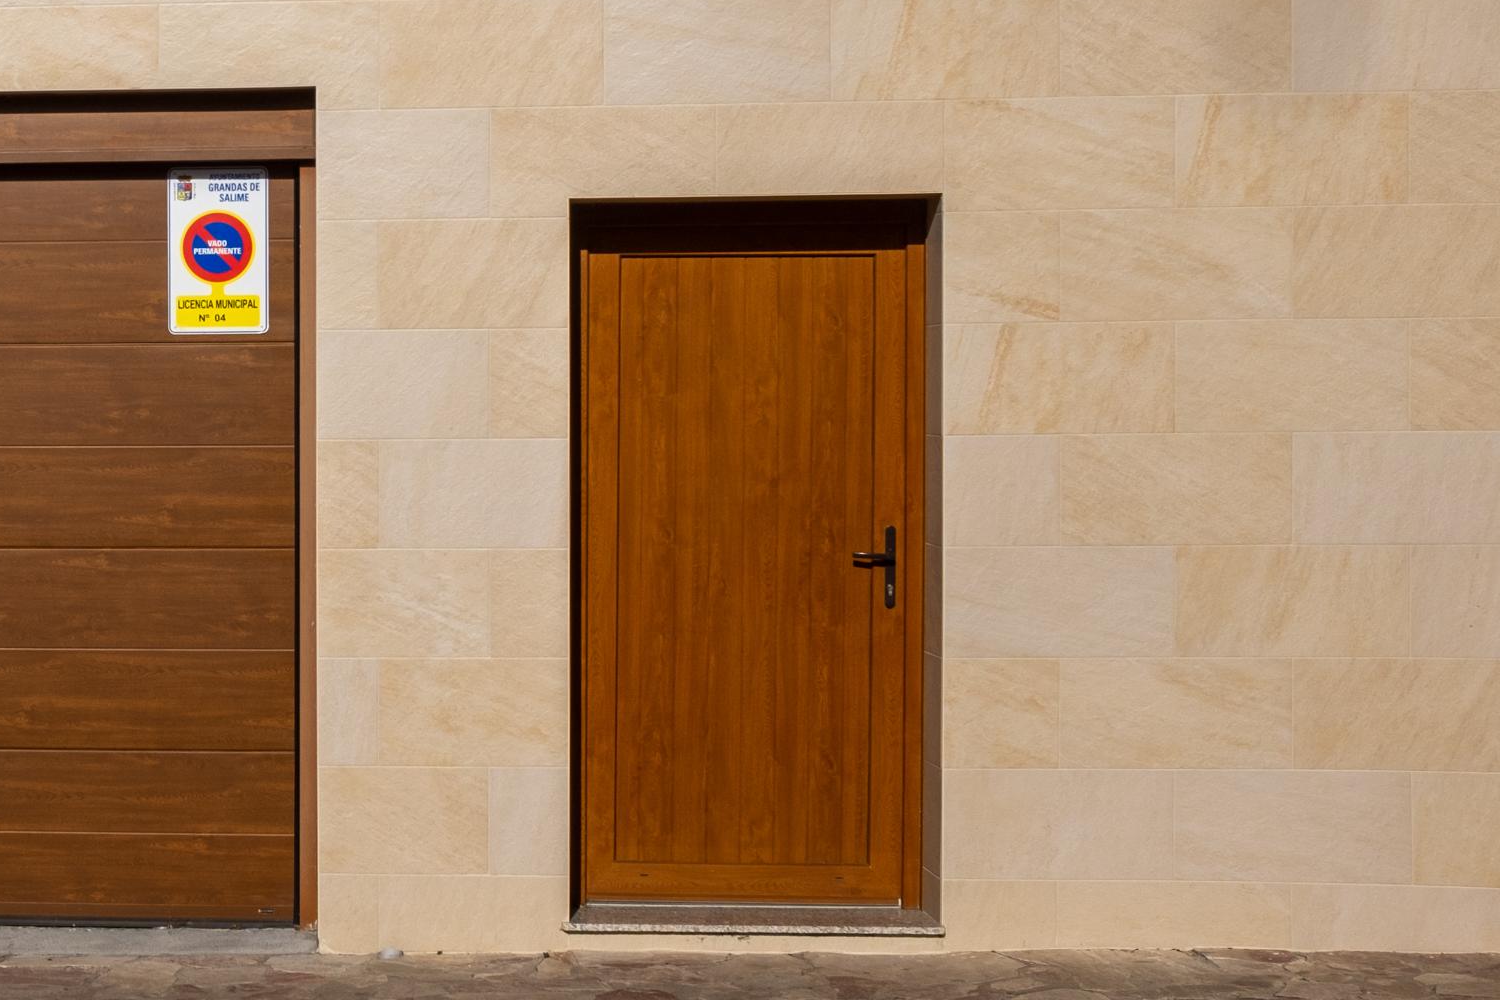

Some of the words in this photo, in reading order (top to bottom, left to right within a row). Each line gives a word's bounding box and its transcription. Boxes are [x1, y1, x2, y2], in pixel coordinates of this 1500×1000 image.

[208, 183, 248, 192] GRANDAS
[249, 182, 260, 191] DE
[219, 193, 249, 202] SALIME
[207, 239, 228, 247] VADO
[193, 247, 242, 255] PERMANENTE
[177, 299, 214, 309] LICENCIA
[215, 299, 258, 309] MUNICIPAL
[214, 314, 226, 322] 04
